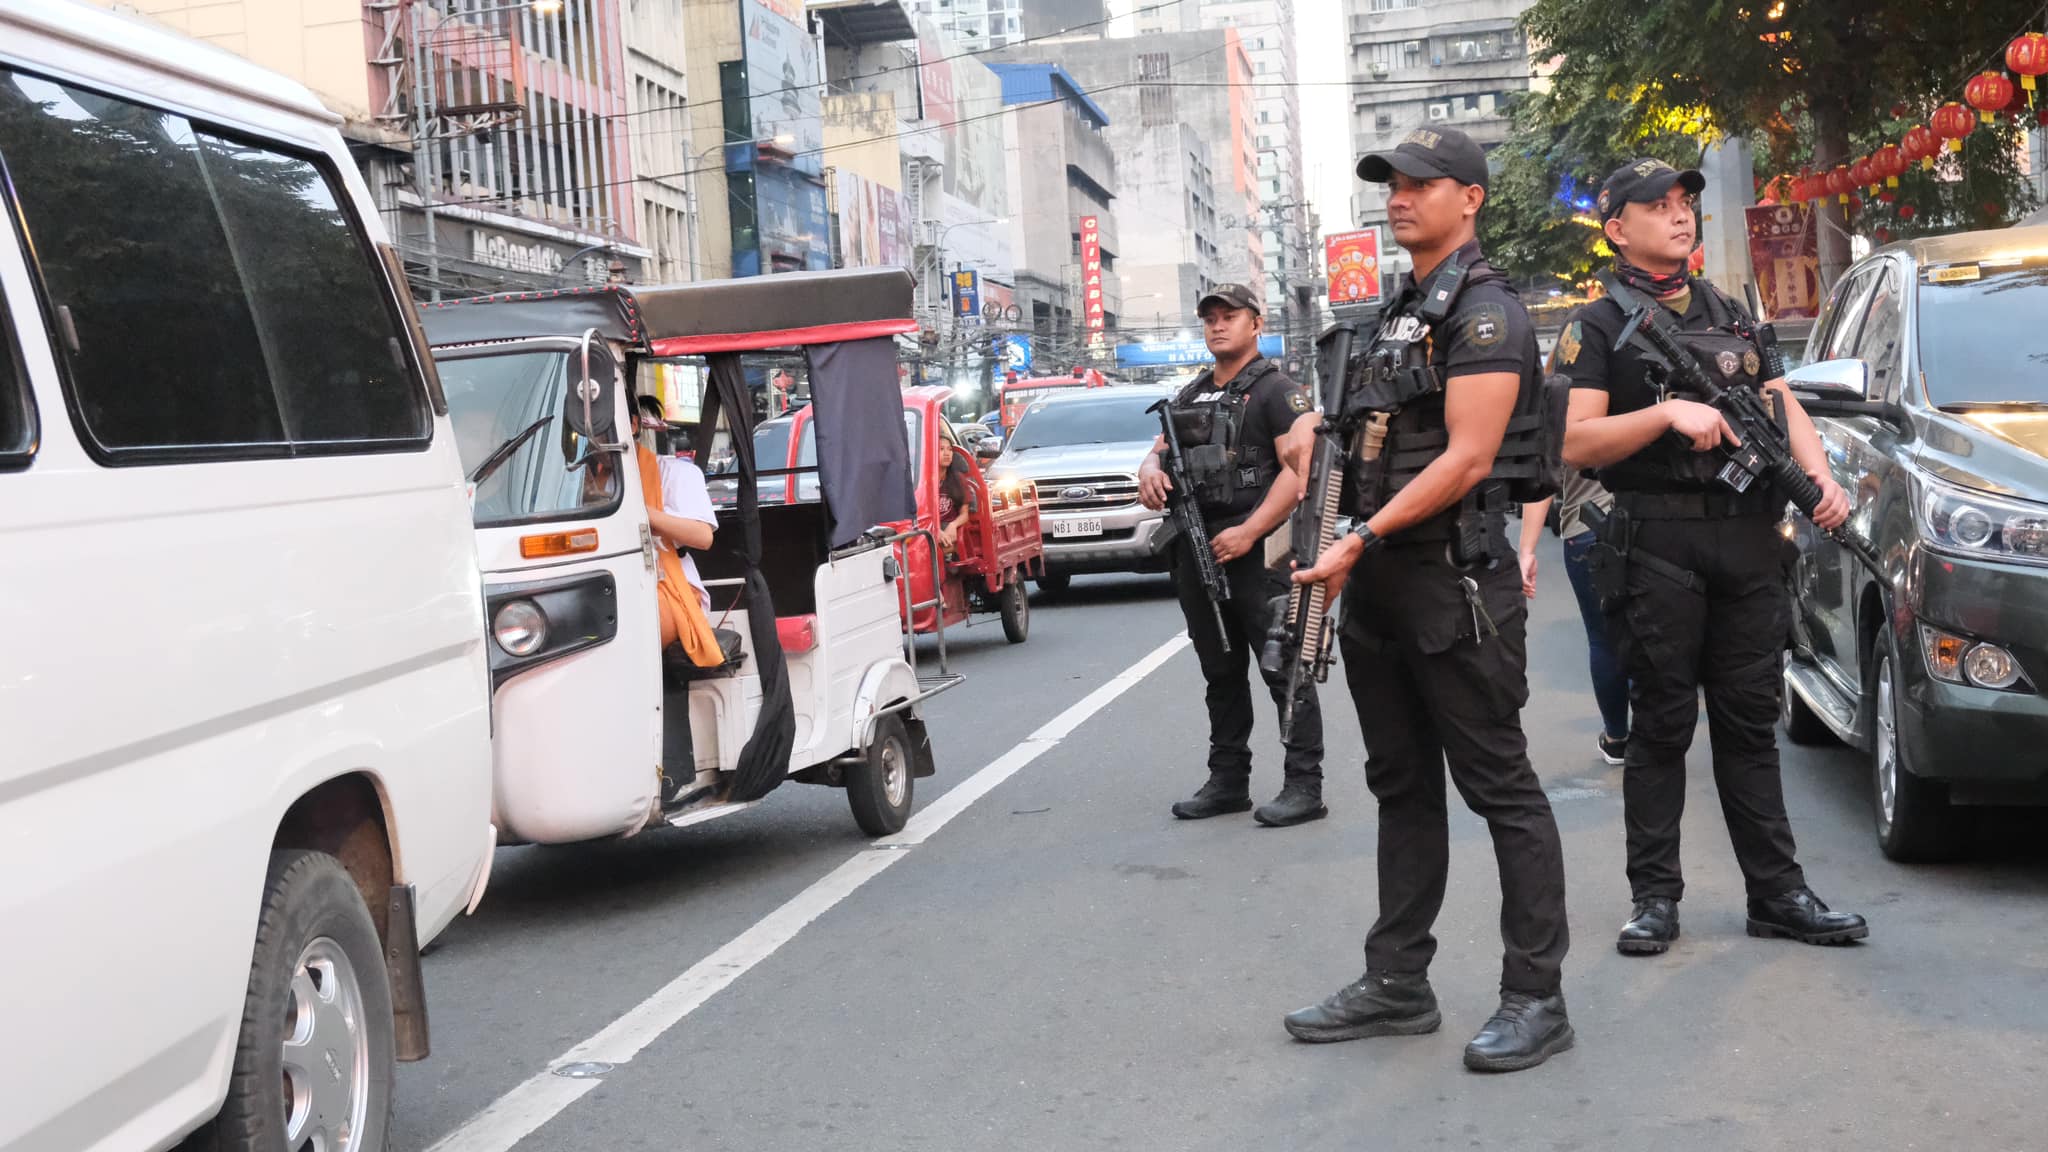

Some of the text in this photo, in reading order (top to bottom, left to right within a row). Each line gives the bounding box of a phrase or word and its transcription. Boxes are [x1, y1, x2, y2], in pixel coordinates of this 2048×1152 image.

[473, 229, 563, 274] McDonald's
[1084, 218, 1104, 344] CHINABANK
[1054, 523, 1071, 534] NBI
